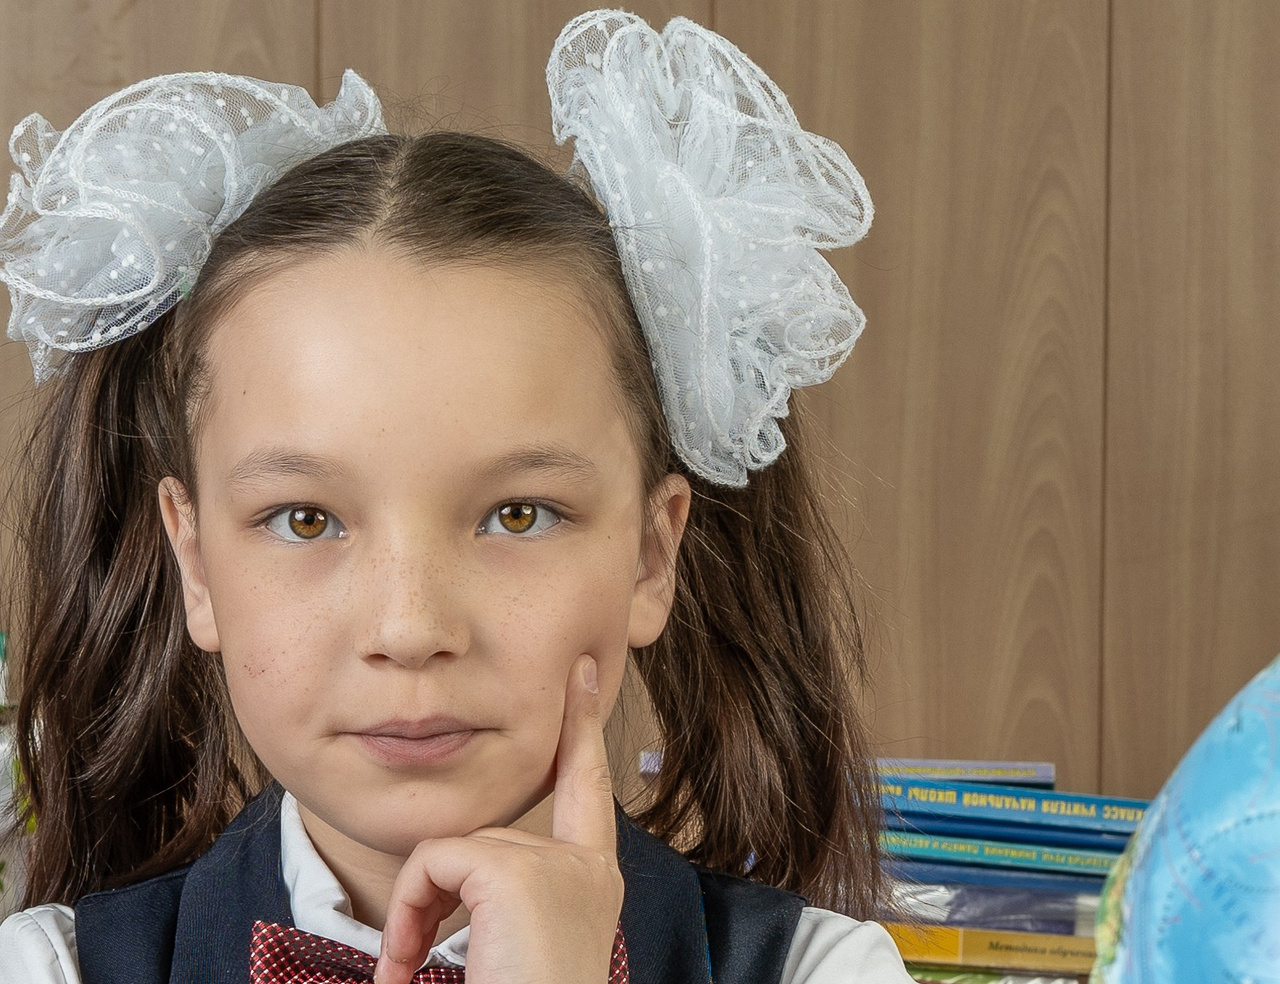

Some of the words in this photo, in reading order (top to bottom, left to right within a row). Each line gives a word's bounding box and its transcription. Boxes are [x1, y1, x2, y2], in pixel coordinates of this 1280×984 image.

[906, 786, 957, 805] ШКОЛЫ
[962, 791, 1035, 813] НАЧАЛЬНОЙ
[1041, 798, 1097, 818] УЧИТЕЛЯ
